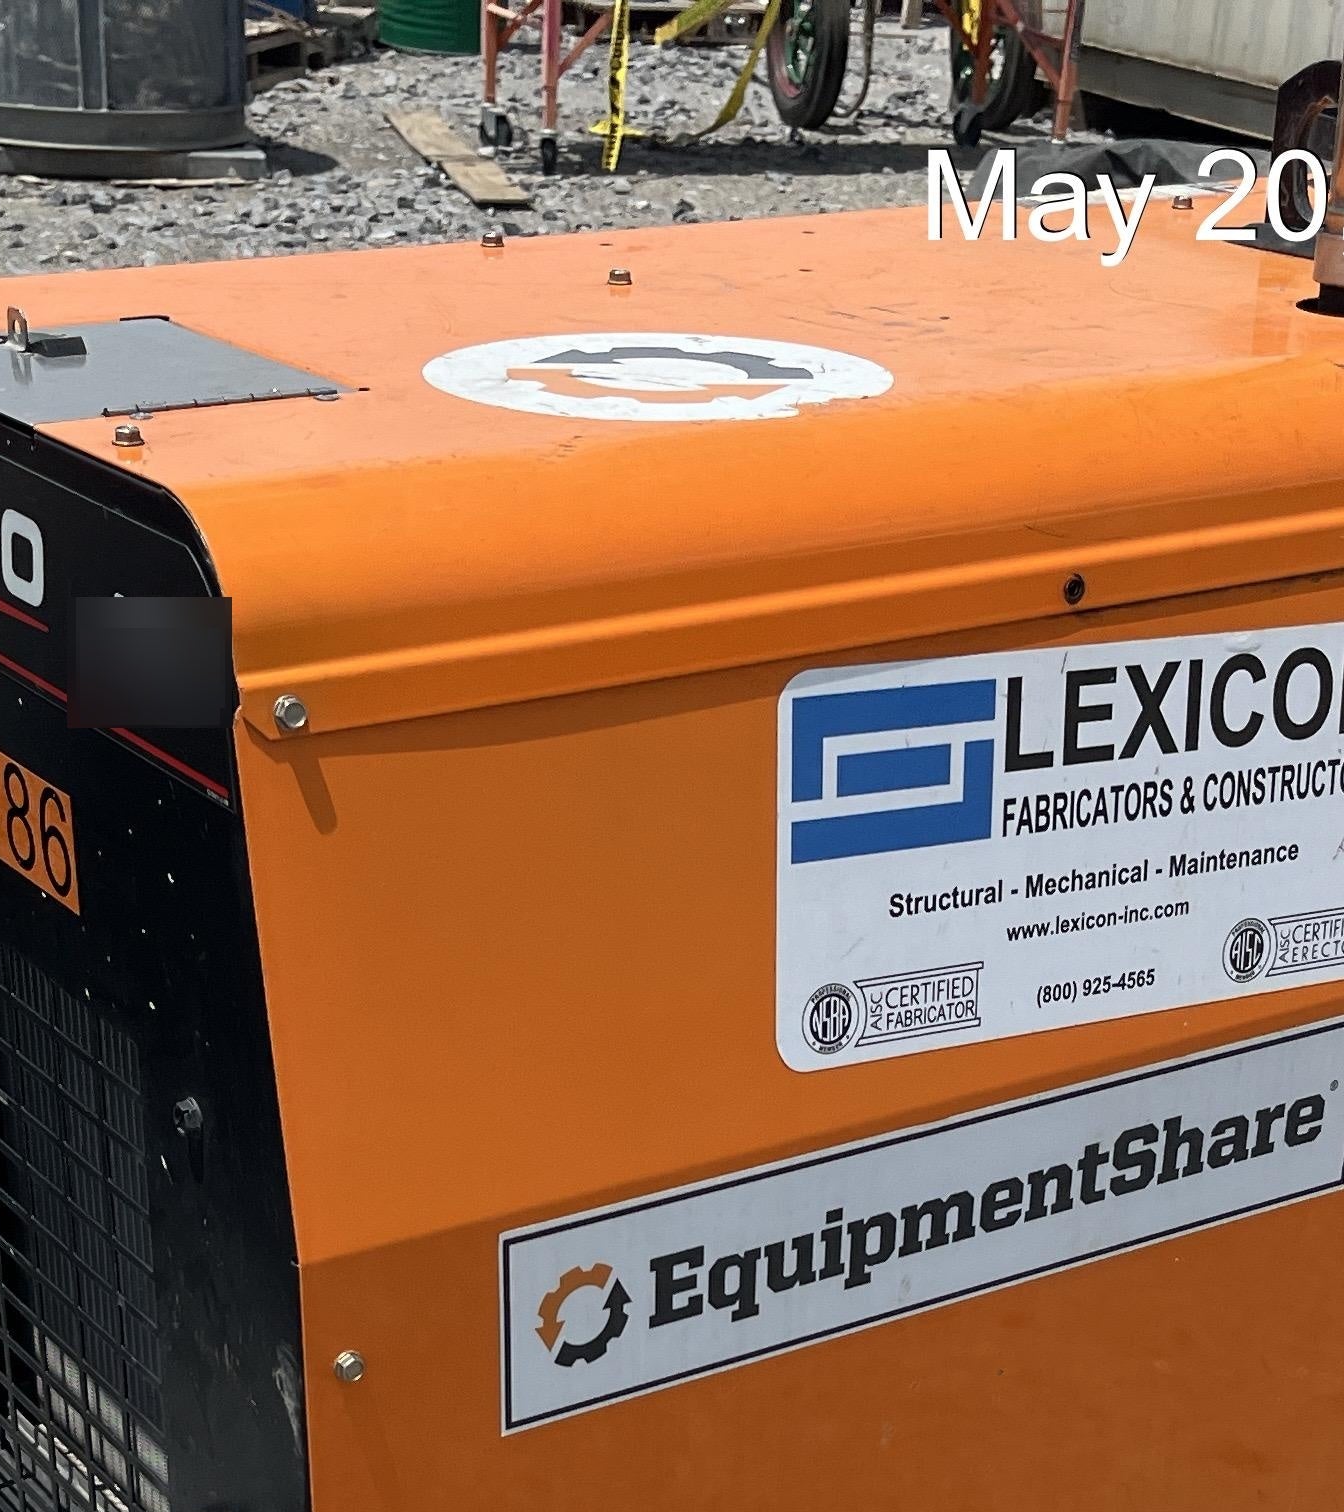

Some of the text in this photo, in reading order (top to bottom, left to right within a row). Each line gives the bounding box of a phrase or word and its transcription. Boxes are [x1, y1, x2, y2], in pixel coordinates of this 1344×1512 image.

[1001, 777, 1174, 838] FABRICATORS
[1180, 775, 1195, 814] &
[888, 879, 1004, 918] Structural
[1024, 859, 1149, 899] Mechanical
[1168, 843, 1300, 879] Maintenance
[1006, 899, 1191, 942] www.lexicon-inc.com
[1231, 930, 1262, 971] AISC
[1278, 928, 1292, 963] AISC
[885, 975, 975, 1010] CERTIFIED
[1036, 968, 1156, 1009] (800) 925-4565
[812, 995, 850, 1043] NSBA
[870, 991, 884, 1031] AISC
[886, 999, 976, 1031] FABRICATOR
[647, 1090, 1326, 1329] EquipmentShare
